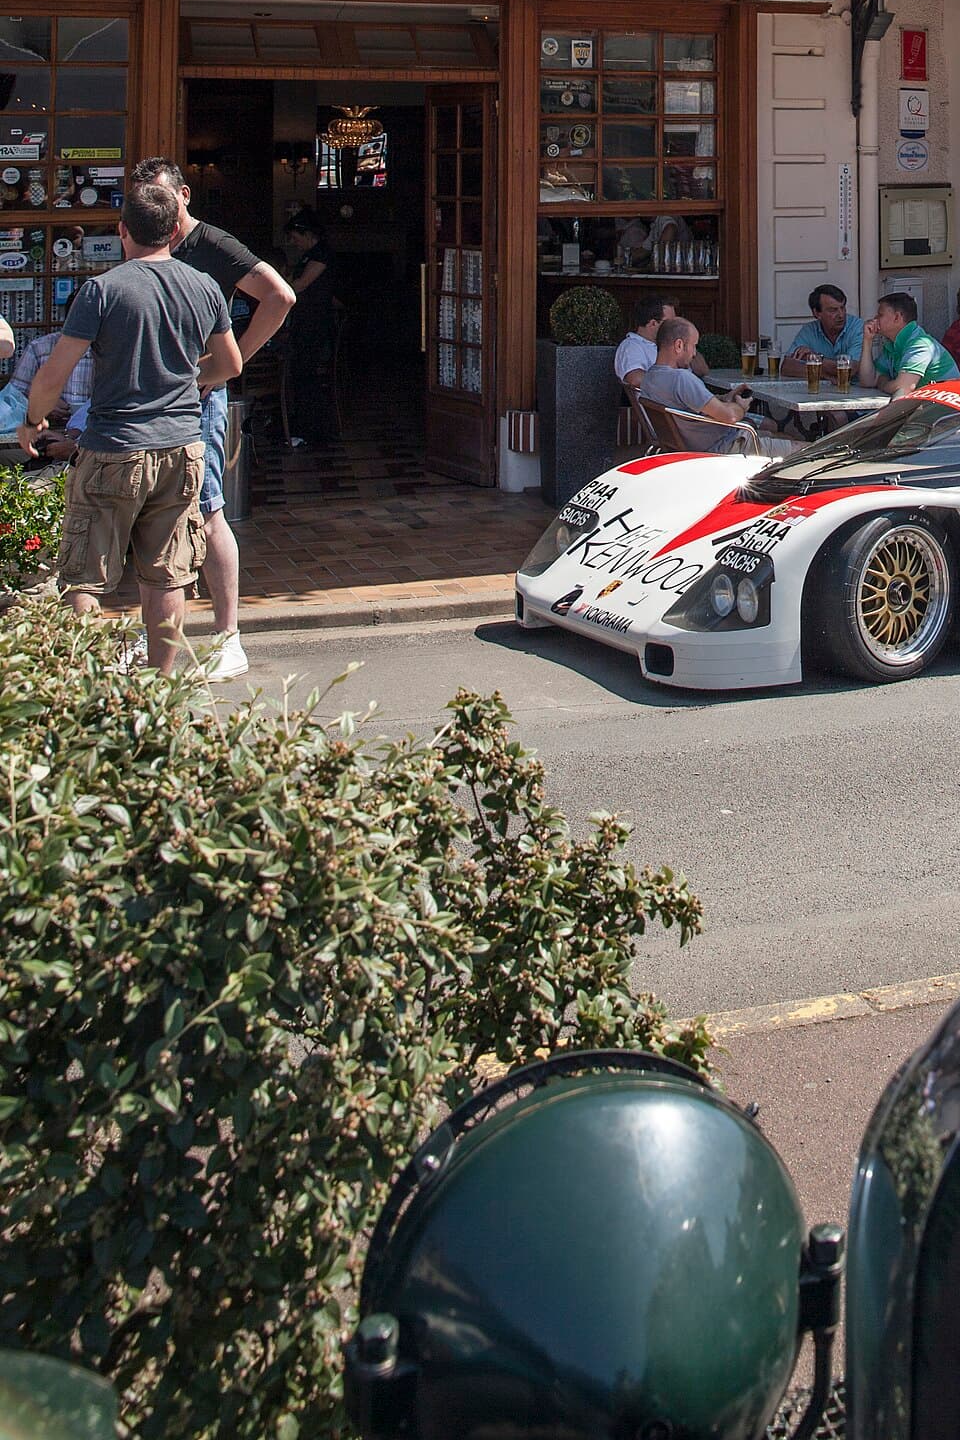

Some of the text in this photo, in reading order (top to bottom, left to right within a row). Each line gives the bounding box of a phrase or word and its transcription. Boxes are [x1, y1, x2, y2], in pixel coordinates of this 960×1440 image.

[572, 491, 607, 511] Shell
[582, 480, 619, 501] PIAA
[559, 507, 591, 527] SACHS
[747, 519, 792, 541] PIAA
[735, 532, 779, 554] Shell
[720, 549, 761, 573] SACHS
[582, 605, 634, 634] YOKOHAMA
